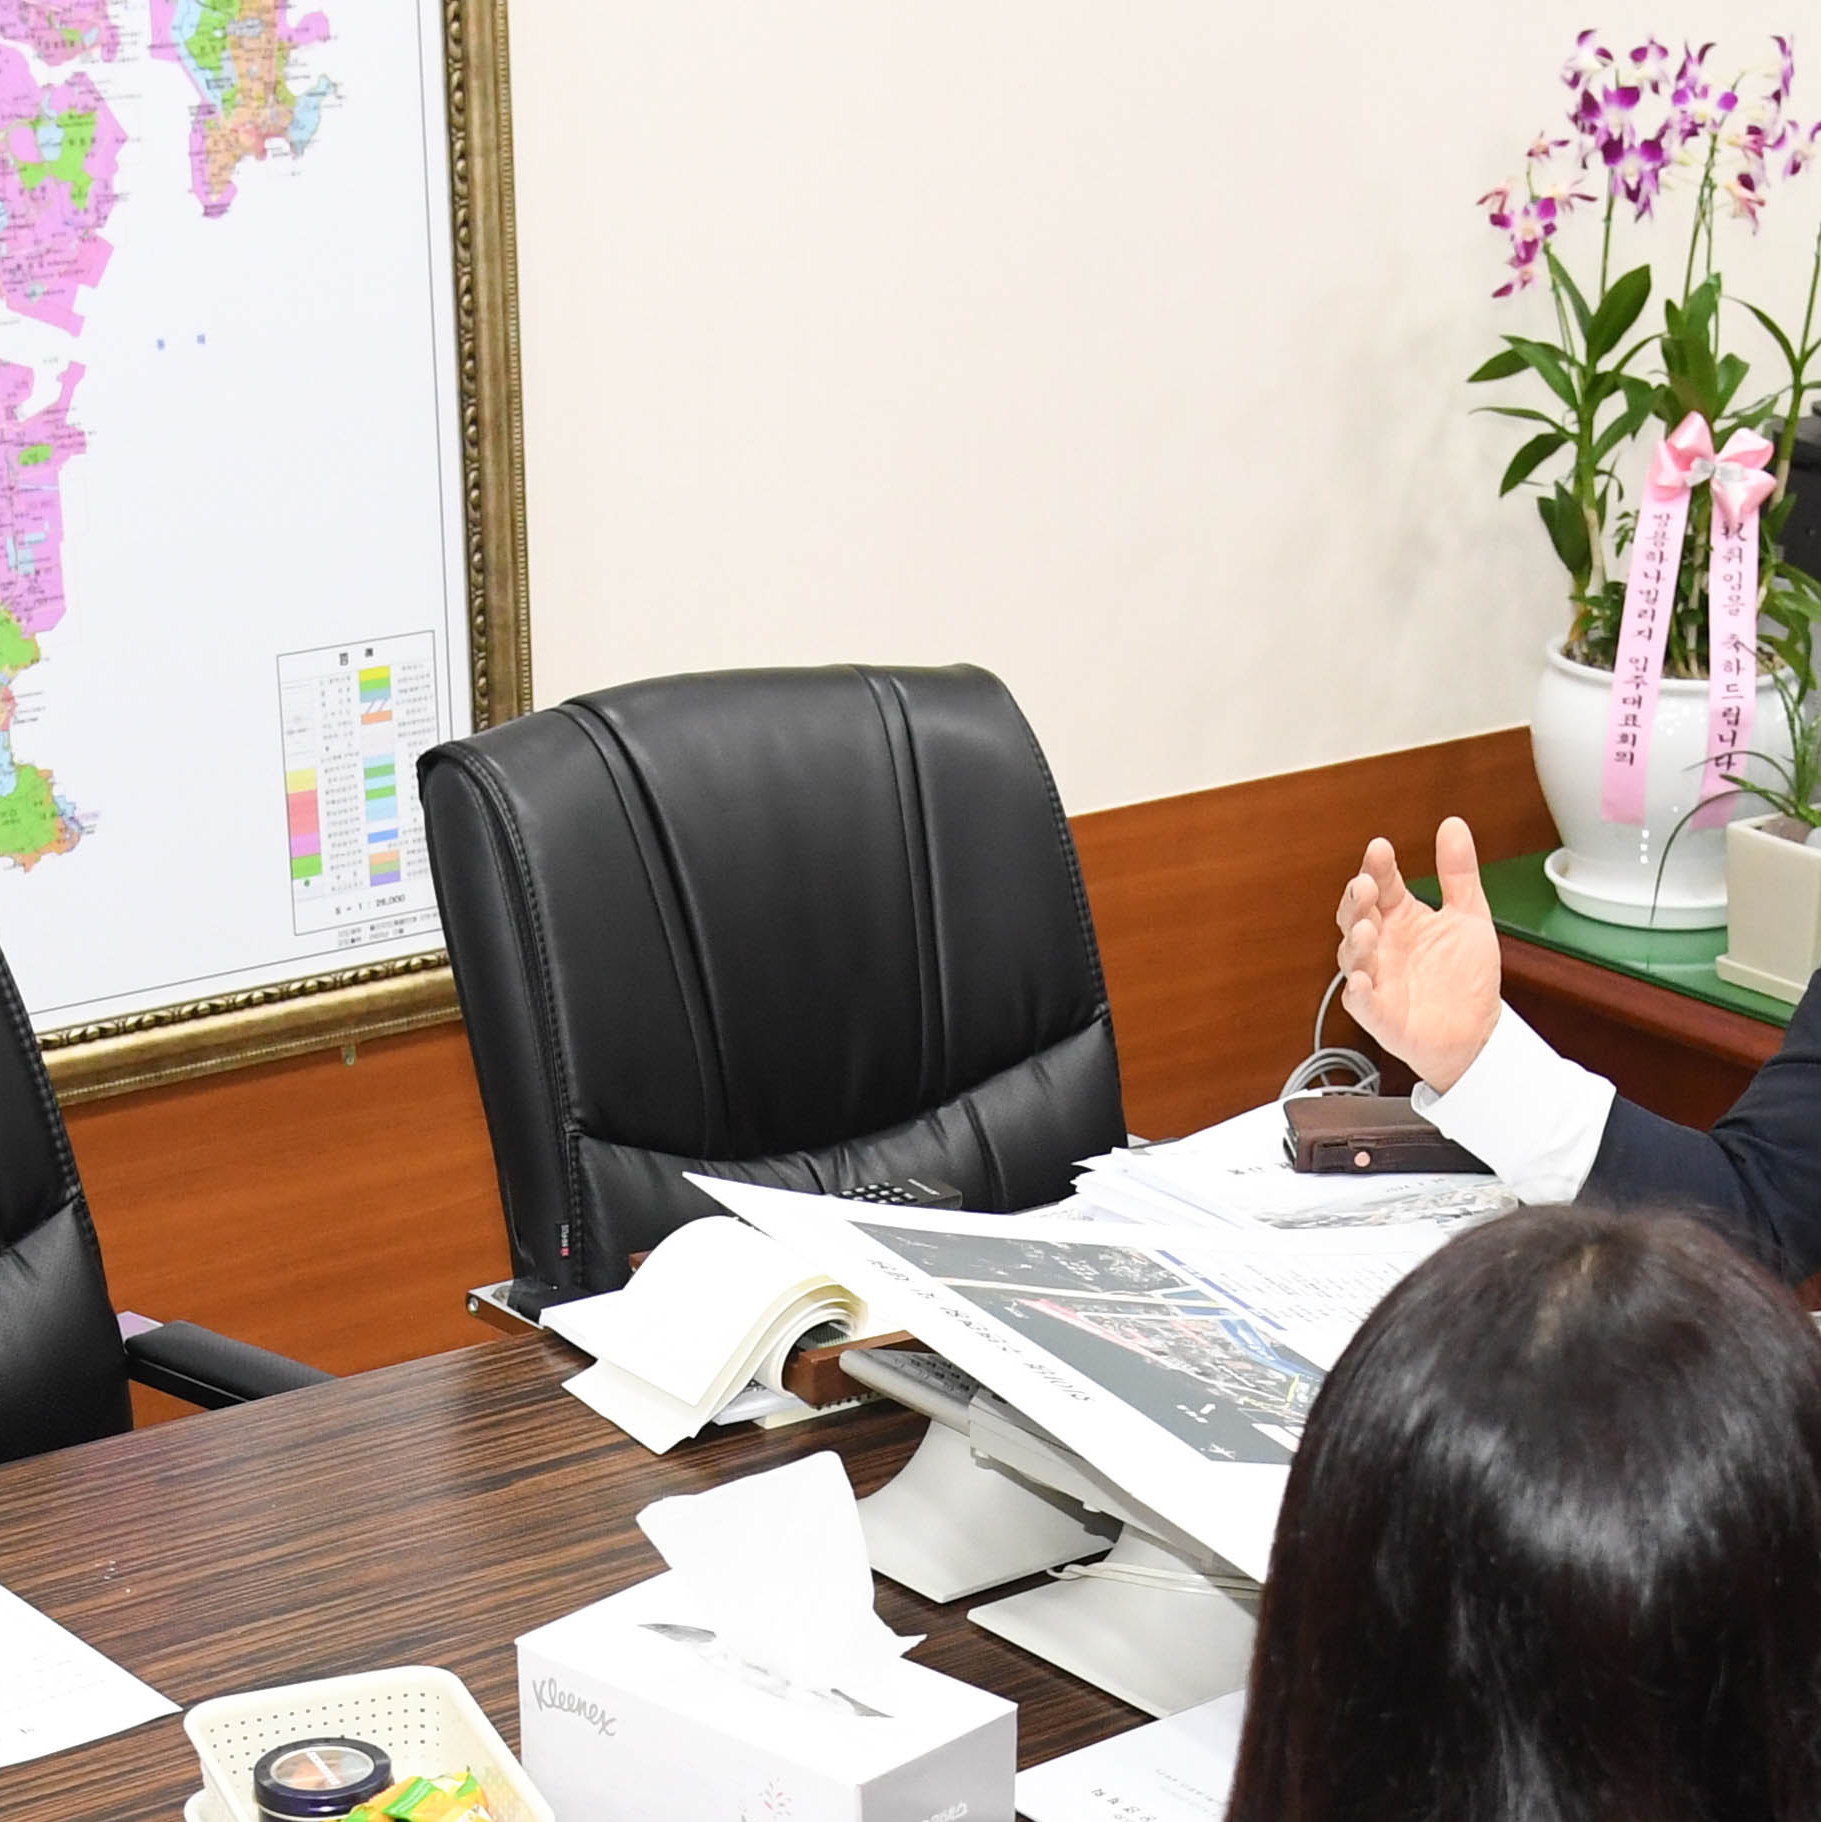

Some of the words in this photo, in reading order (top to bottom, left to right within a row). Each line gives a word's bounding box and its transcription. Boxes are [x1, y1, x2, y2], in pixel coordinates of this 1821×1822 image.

[1614, 654, 1650, 768] 입주대표회의
[1712, 630, 1746, 773] 축하드립니다
[531, 1677, 619, 1738] Kleenex
